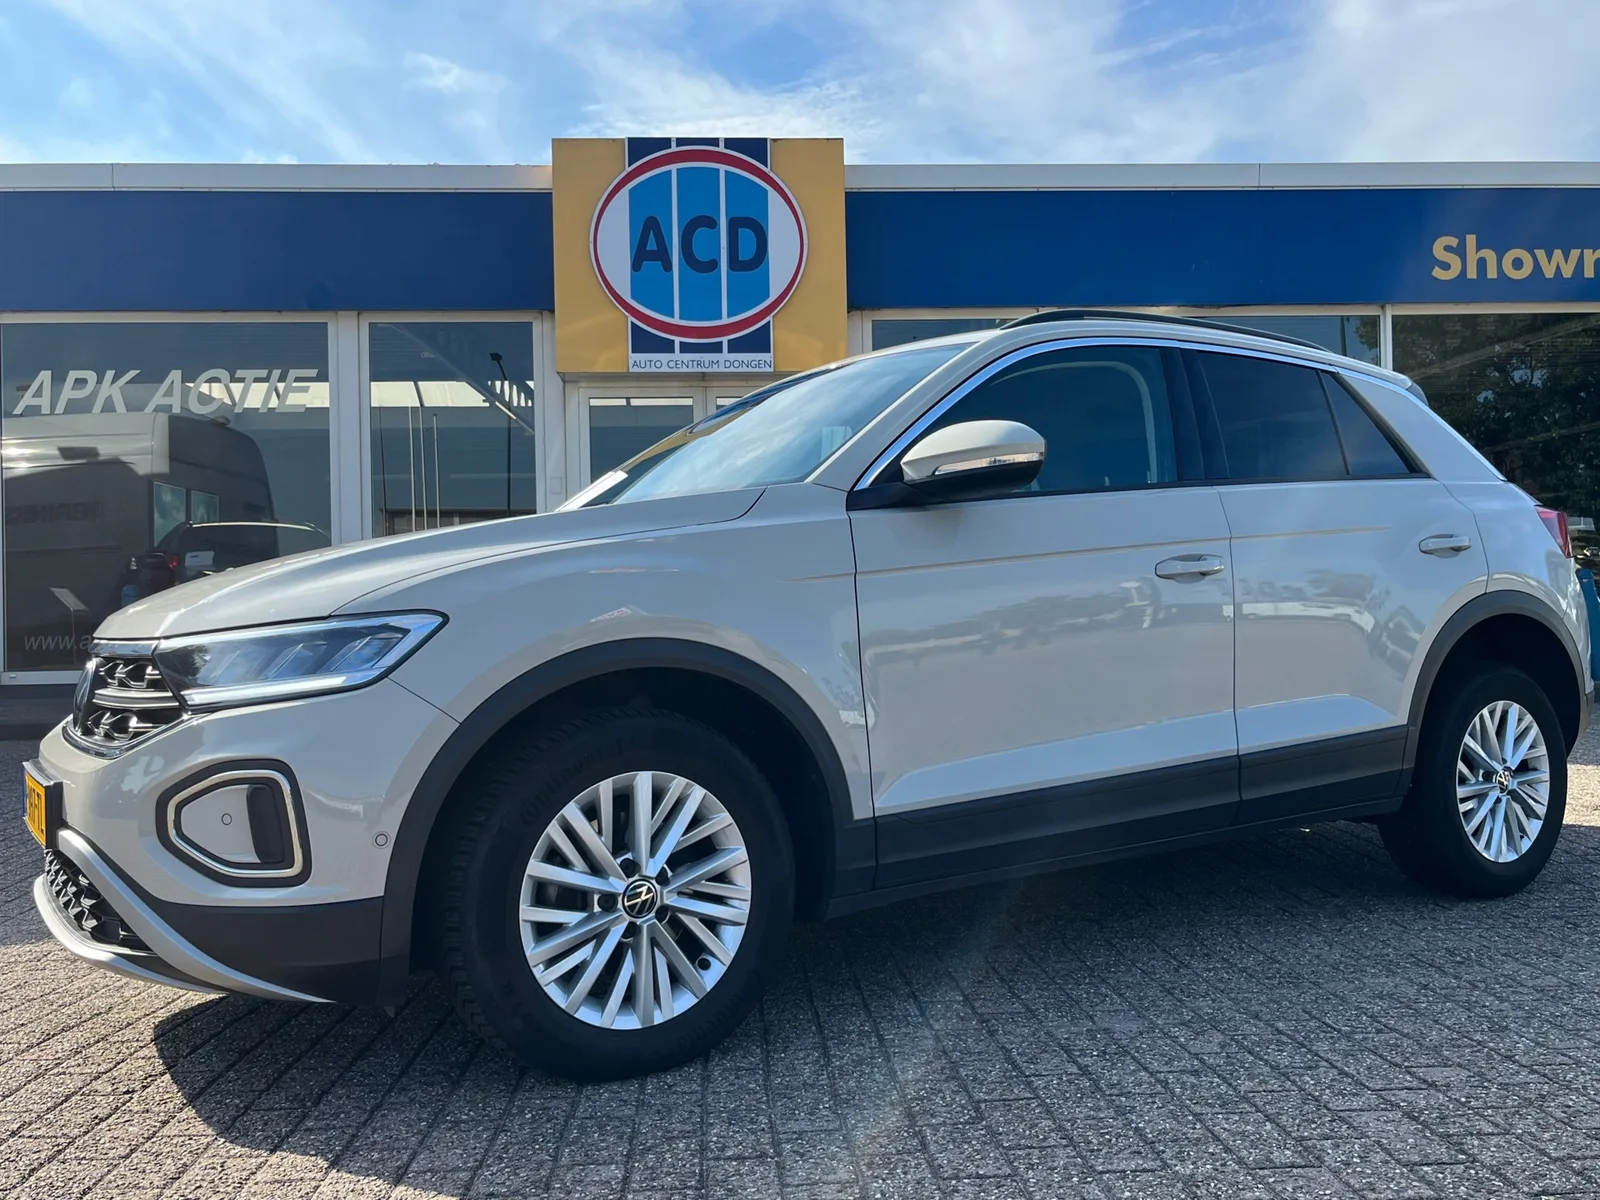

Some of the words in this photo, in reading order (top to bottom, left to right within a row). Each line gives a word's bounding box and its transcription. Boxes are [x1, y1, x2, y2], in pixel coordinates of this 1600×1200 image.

[632, 215, 767, 274] ACD
[632, 359, 663, 369] AUTO
[667, 359, 720, 369] CENTRUM
[723, 359, 772, 369] DONGEN
[13, 369, 141, 415] APK
[144, 368, 319, 414] ACTIE
